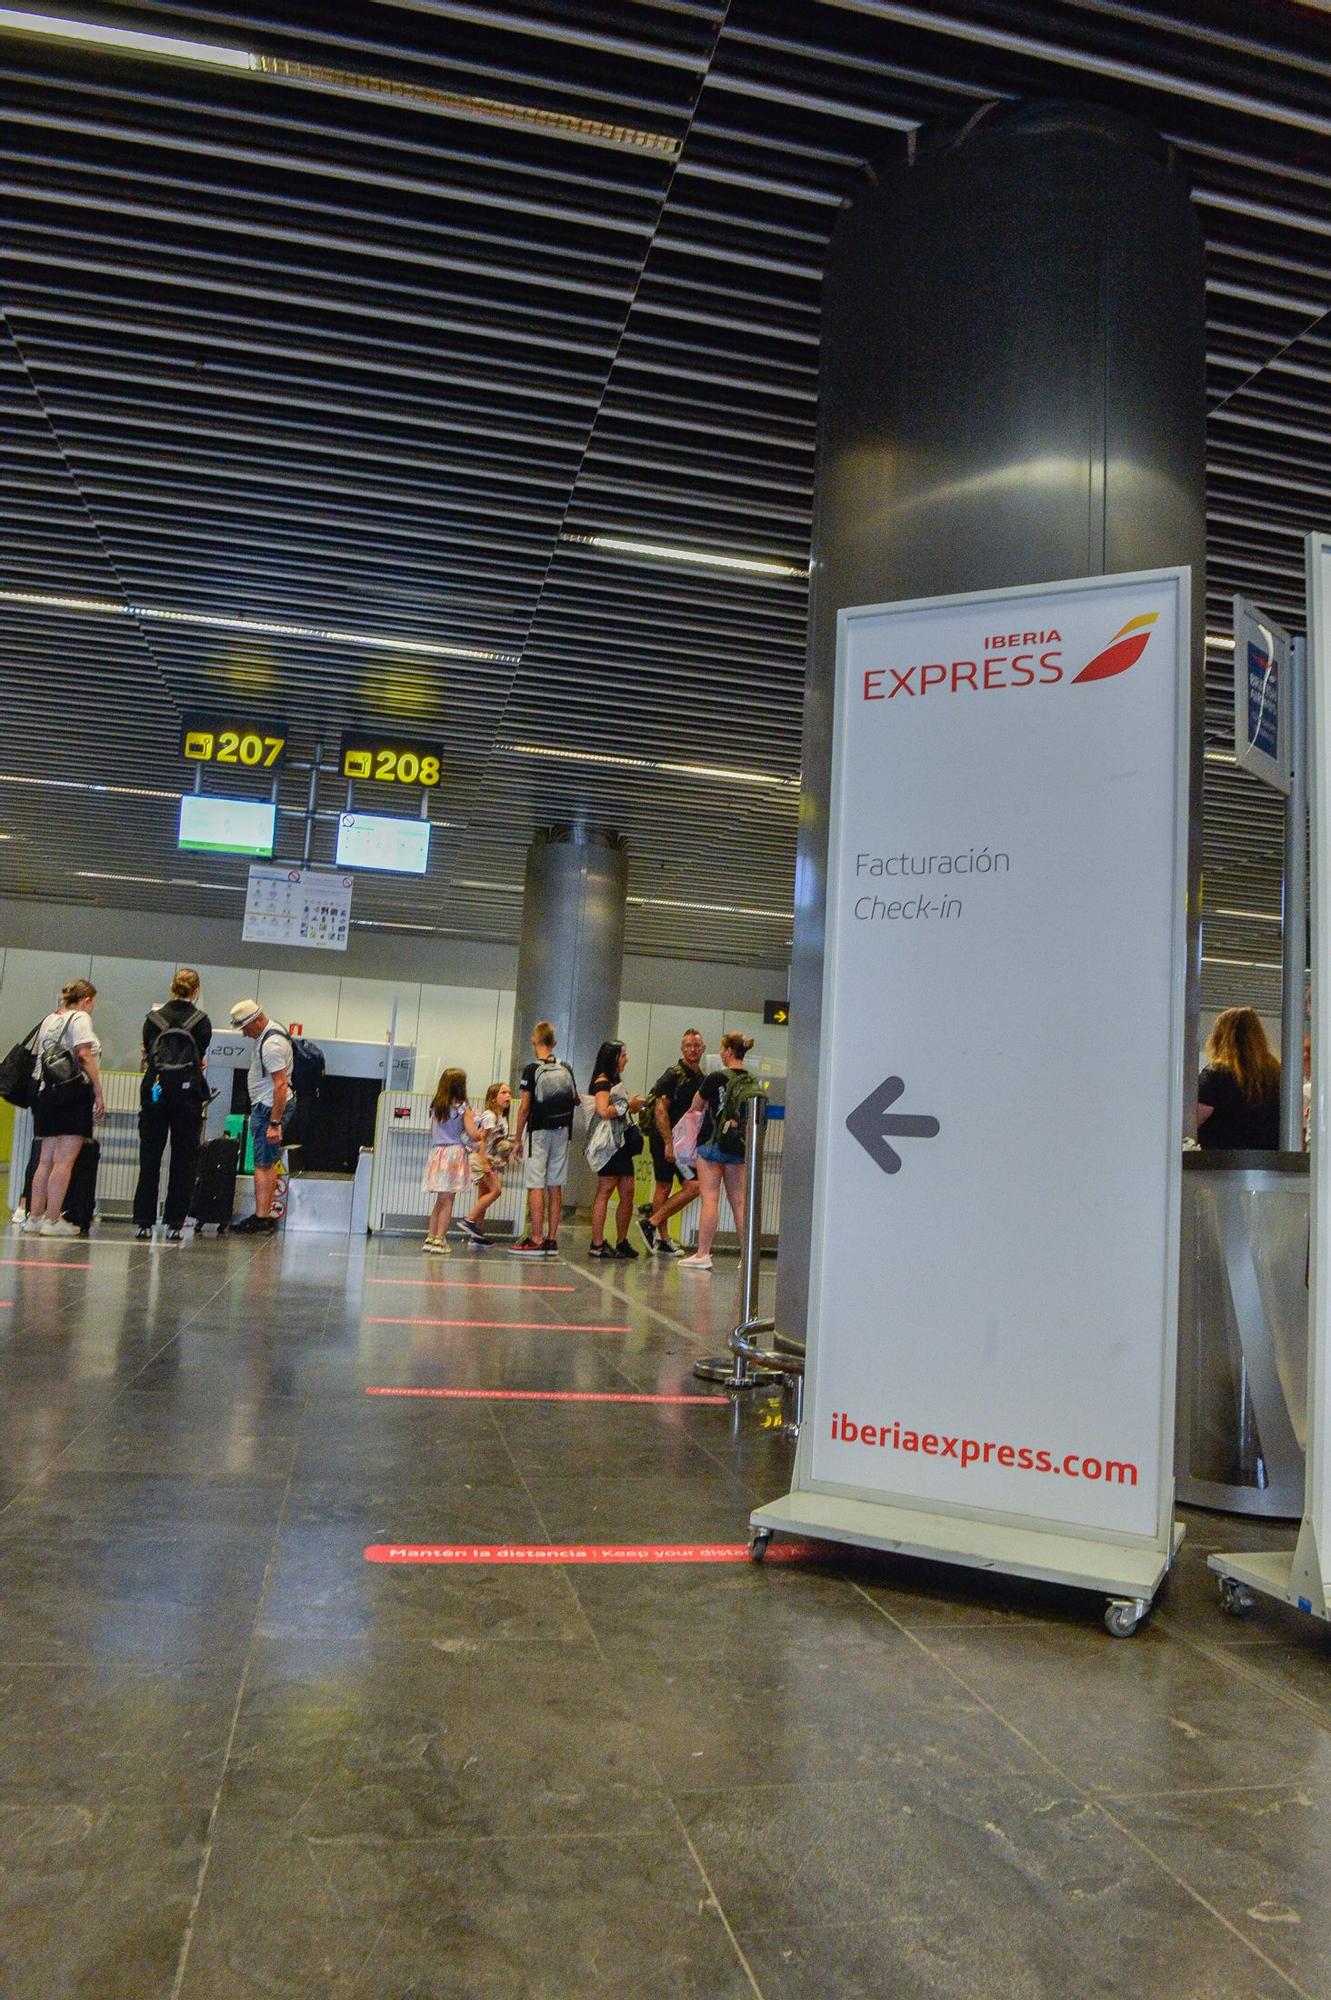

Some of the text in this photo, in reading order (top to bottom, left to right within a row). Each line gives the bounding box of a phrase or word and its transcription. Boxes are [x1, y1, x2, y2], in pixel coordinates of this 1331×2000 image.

[984, 630, 1062, 650] IBERIA
[863, 652, 1064, 701] EXPRESS
[216, 732, 286, 767] 207
[375, 750, 440, 786] 208
[856, 846, 1010, 877] Facturación
[854, 893, 962, 920] Check-in
[211, 1045, 246, 1057] 207
[830, 1411, 1138, 1487] iberiaexpress.com
[472, 1548, 491, 1558] la
[496, 1548, 587, 1558] distancia
[601, 1549, 649, 1559] Keep
[655, 1550, 695, 1559] your
